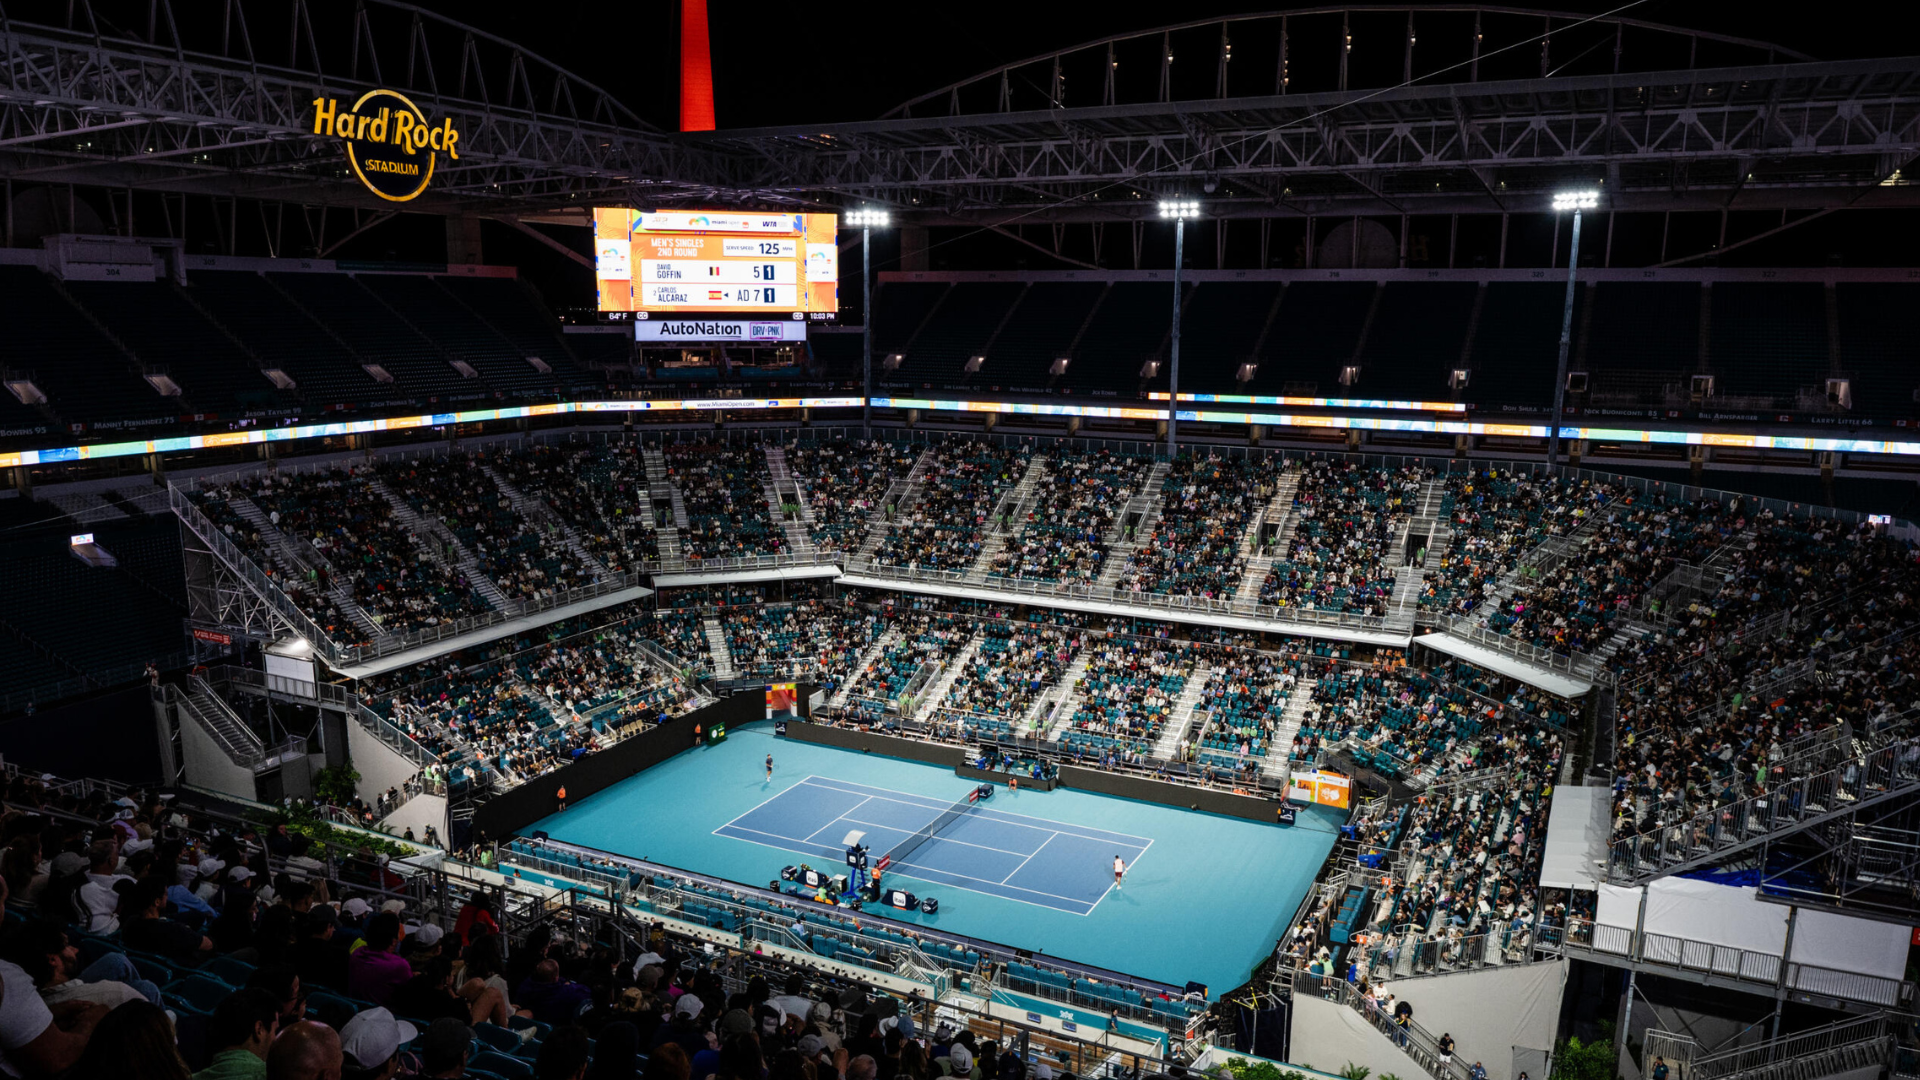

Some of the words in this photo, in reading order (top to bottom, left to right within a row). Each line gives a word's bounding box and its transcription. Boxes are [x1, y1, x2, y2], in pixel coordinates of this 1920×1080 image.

[313, 97, 389, 143] Hard
[392, 109, 459, 160] Rock
[366, 159, 419, 176] STADIUM
[651, 238, 674, 248] MEN'S
[675, 239, 704, 249] SINGLES
[657, 247, 673, 256] 2ND
[674, 248, 698, 257] ROUND
[758, 243, 780, 255] 125
[203, 258, 216, 266] 305
[657, 270, 682, 279] GOFFIN
[753, 266, 761, 279] 5
[658, 286, 677, 294] CARLOS
[658, 293, 688, 303] ALCARAZ
[737, 289, 750, 302] AD
[754, 289, 761, 302] 7
[810, 312, 825, 320] 10:03
[825, 312, 835, 320] PM
[660, 322, 742, 335] AutoNation
[752, 326, 766, 336] DRV
[767, 326, 780, 336] PNK
[244, 410, 265, 418] JASON
[1713, 413, 1758, 421] ARNSPARGER
[93, 422, 122, 430] MANNY
[123, 417, 162, 428] FERNANDEZ
[164, 416, 175, 424] 75
[1811, 416, 1835, 424] LARRY
[1837, 418, 1860, 426] LITTLE
[0, 429, 34, 437] BOWENS
[34, 426, 47, 434] 95
